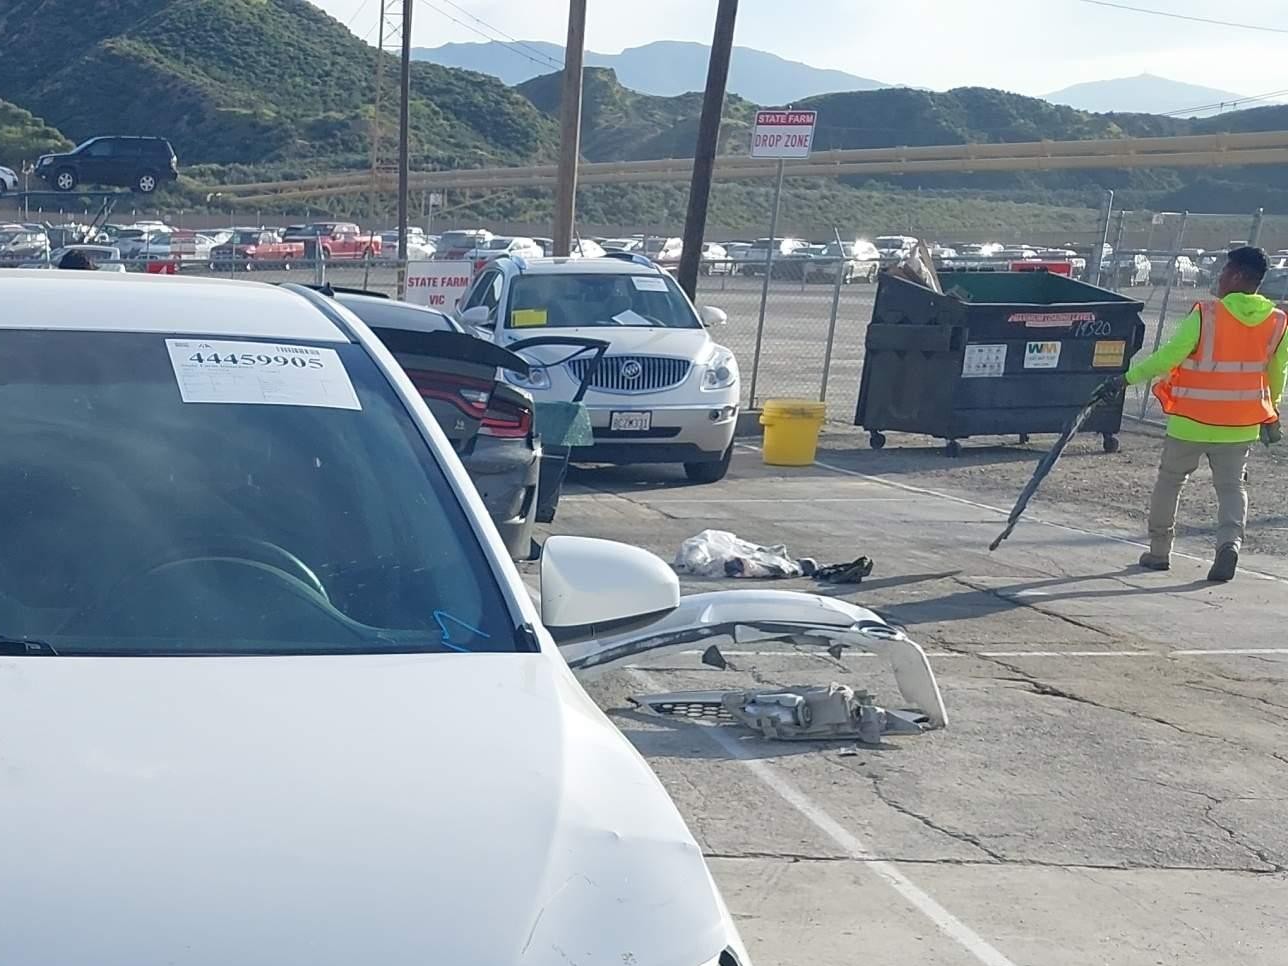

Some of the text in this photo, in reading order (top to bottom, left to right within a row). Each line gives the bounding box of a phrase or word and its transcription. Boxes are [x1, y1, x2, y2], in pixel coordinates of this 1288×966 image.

[758, 114, 814, 123] STATE FARM
[755, 134, 809, 147] DROP ZONE
[408, 276, 469, 288] STATE FARM
[429, 294, 445, 305] VIC
[1028, 343, 1058, 354] WM
[189, 352, 324, 370] 44459905
